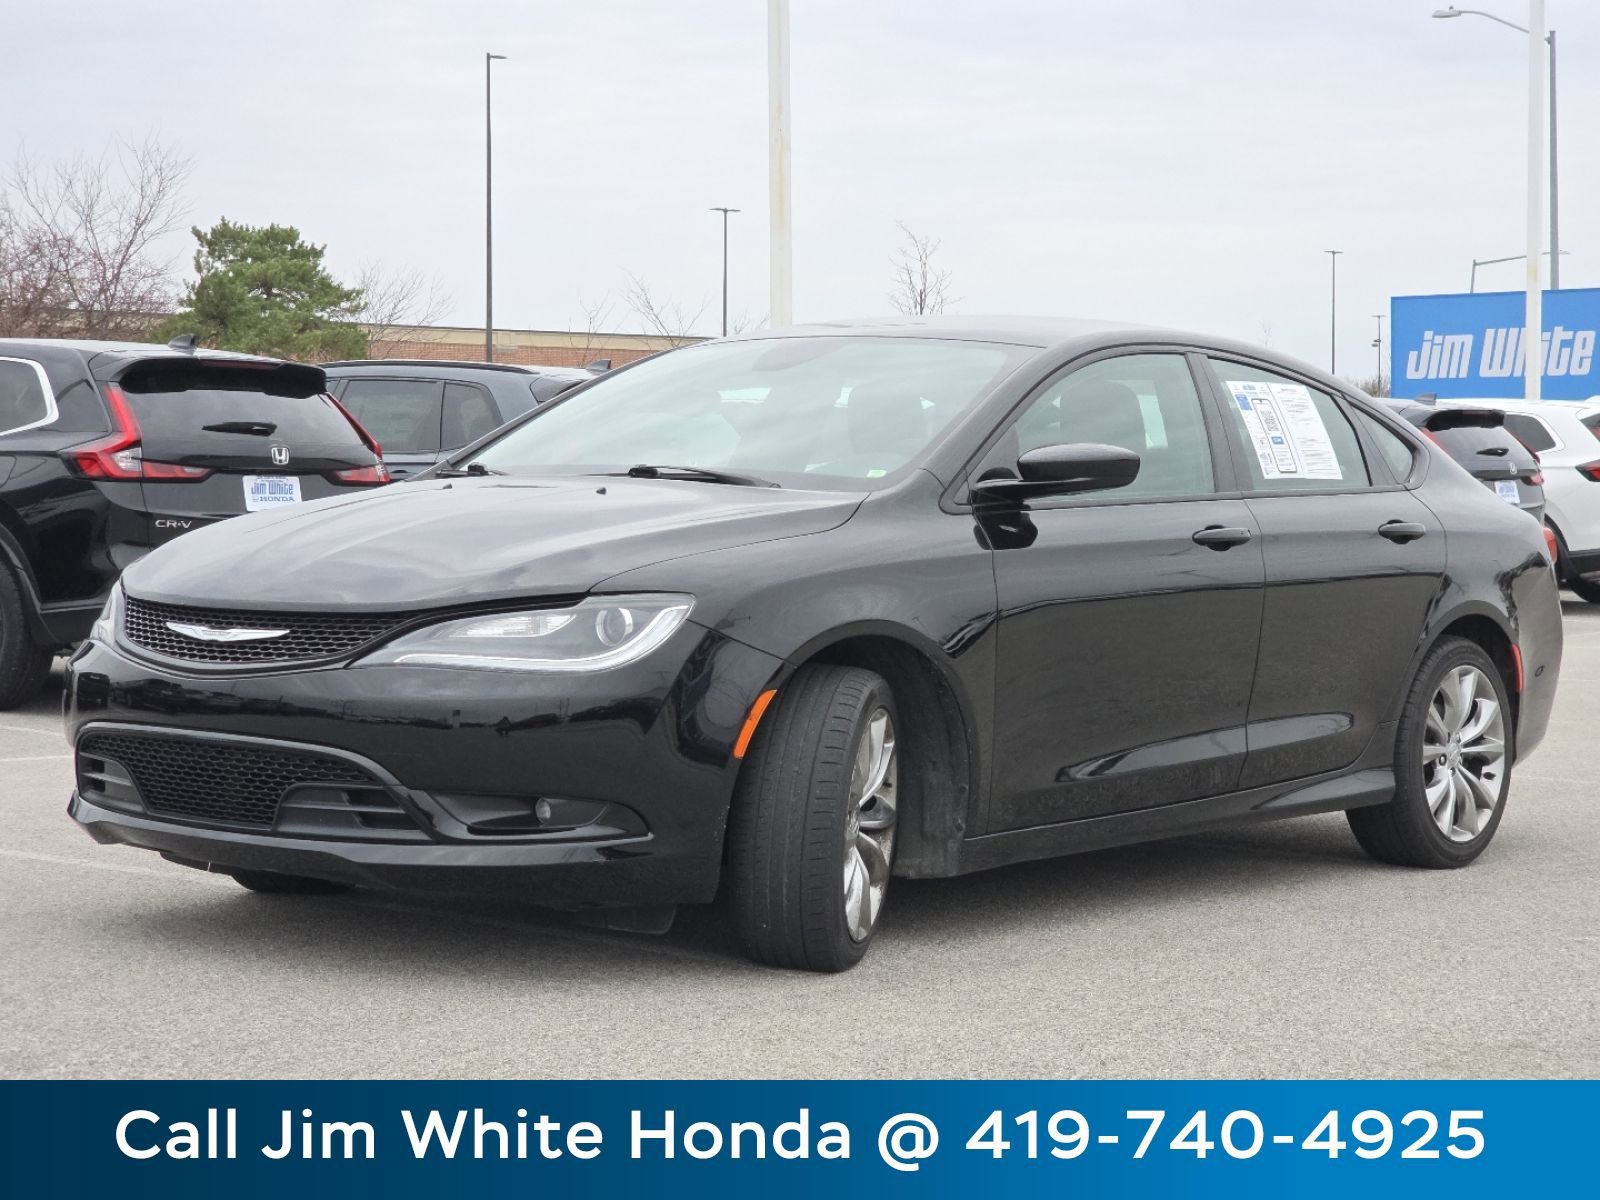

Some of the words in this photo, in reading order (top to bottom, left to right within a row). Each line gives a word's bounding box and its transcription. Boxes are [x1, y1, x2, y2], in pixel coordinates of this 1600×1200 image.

[1406, 331, 1473, 379] Jim
[251, 481, 266, 495] Jim
[268, 480, 293, 495] White
